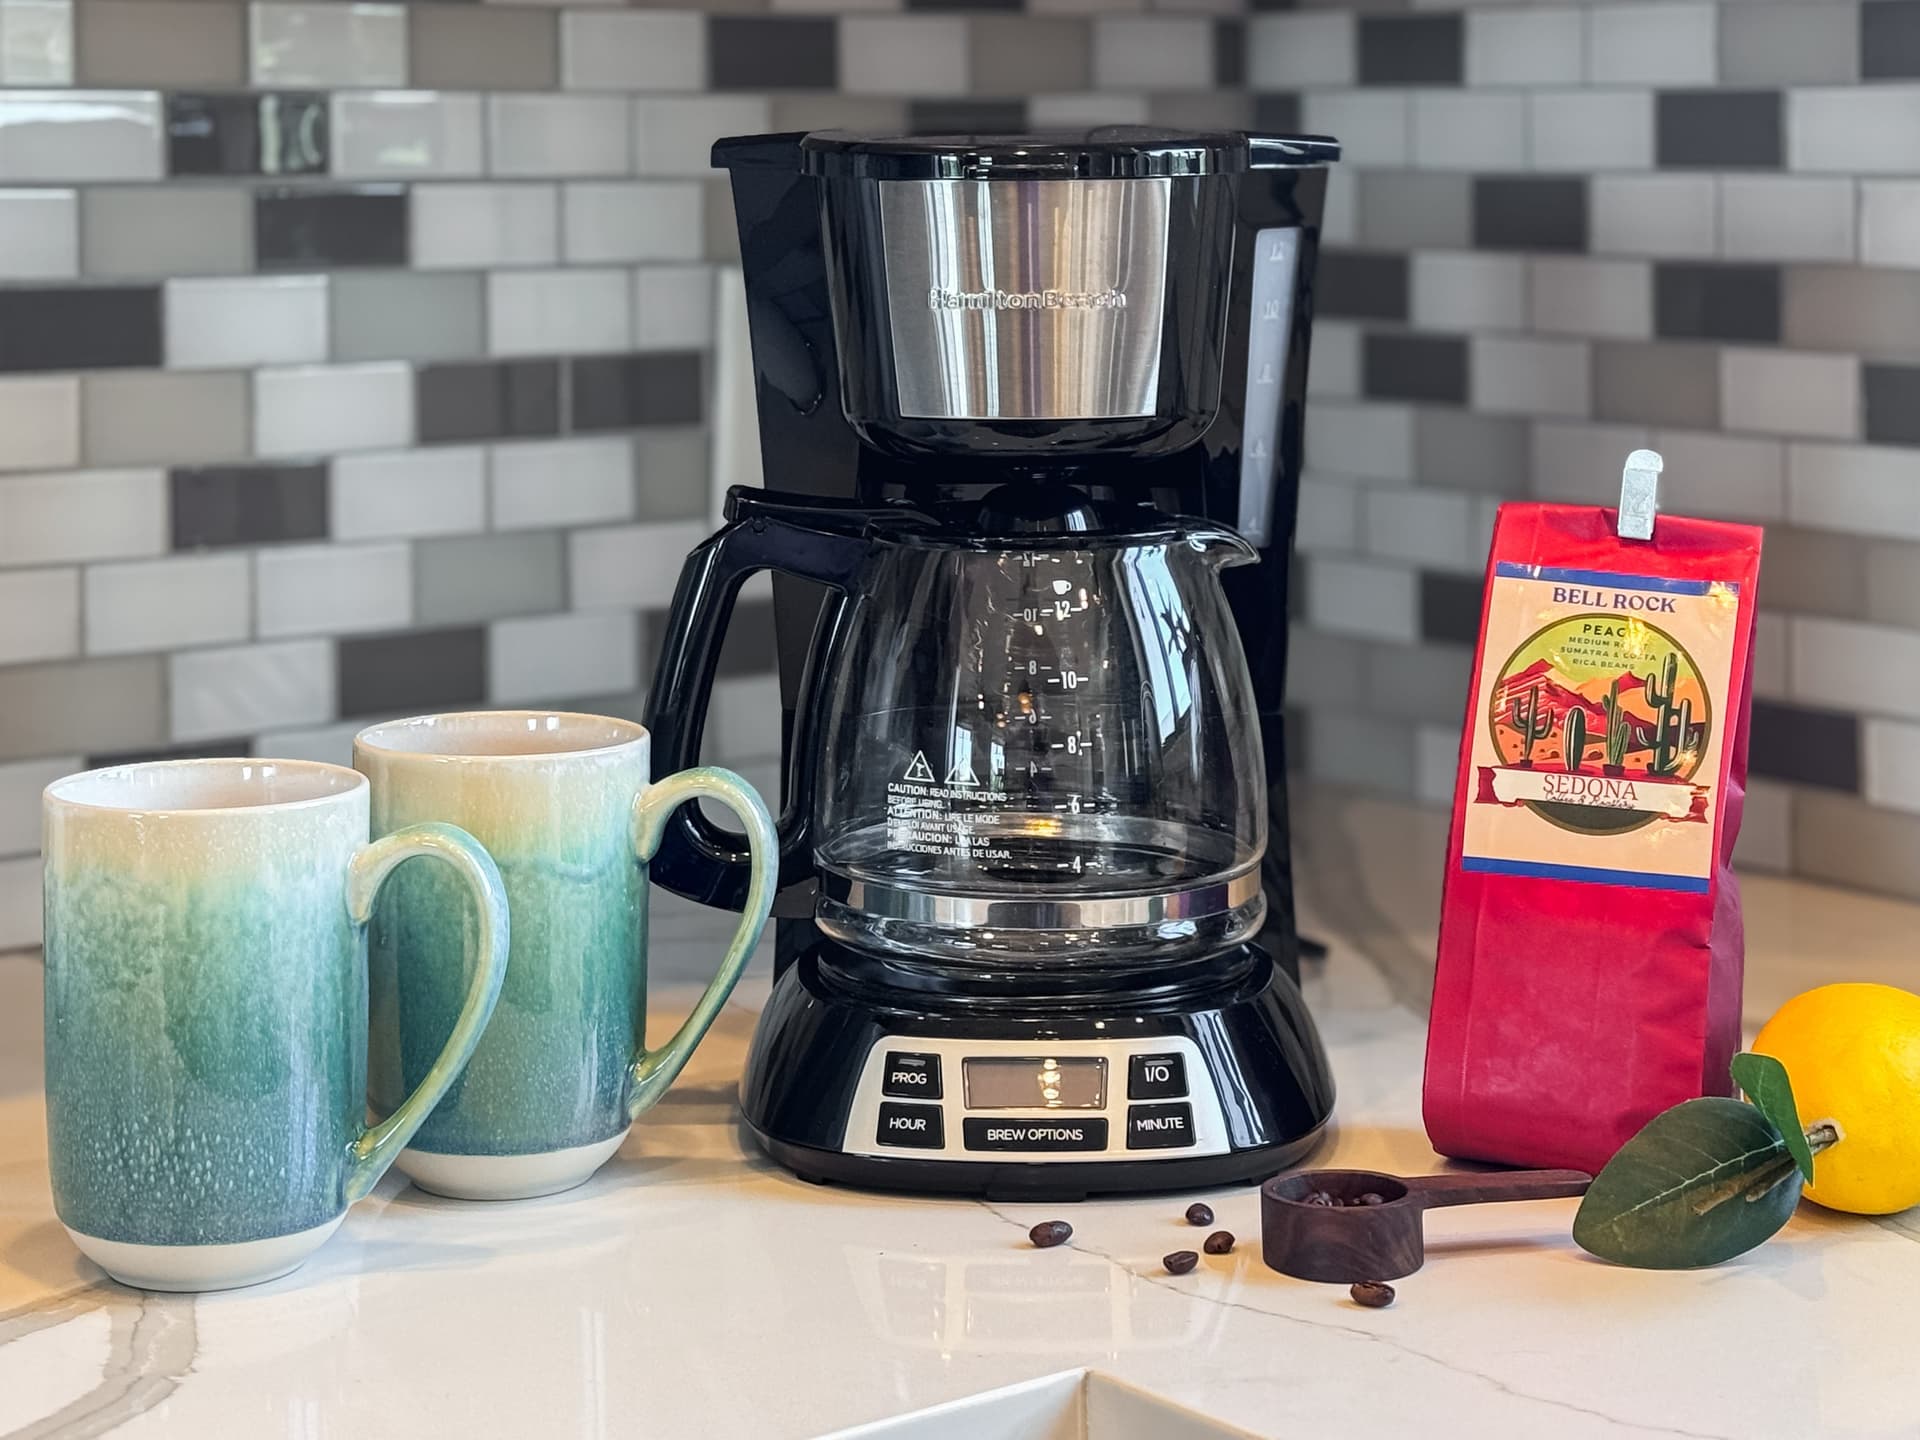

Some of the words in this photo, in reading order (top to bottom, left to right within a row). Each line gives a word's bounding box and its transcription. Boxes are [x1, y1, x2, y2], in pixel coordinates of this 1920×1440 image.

[929, 288, 1041, 310] Hamilton
[1552, 586, 1608, 609] BELL
[1612, 592, 1678, 614] ROCK
[1582, 623, 1631, 638] PEAC
[1568, 636, 1610, 647] MEDIUM
[1614, 640, 1649, 651] ROT
[1560, 646, 1609, 658] SUMATRA
[1572, 658, 1597, 667] RICA
[1061, 671, 1077, 689] 10
[1067, 735, 1077, 754] 8
[888, 782, 929, 796] CAUTION:
[950, 789, 1007, 802] INSTRUCTIONS
[1543, 774, 1639, 801] SEDONA
[975, 814, 1001, 825] MODE
[972, 836, 990, 847] LAS
[972, 848, 985, 858] DE
[985, 849, 1013, 860] USAR.
[1072, 855, 1082, 873] 4
[891, 1071, 928, 1086] PROG
[1144, 1066, 1169, 1083] I/O
[889, 1117, 927, 1132] HOUR
[1136, 1116, 1184, 1132] MINUTE
[986, 1128, 1026, 1142] BREW
[1028, 1127, 1084, 1142] OPTIONS
